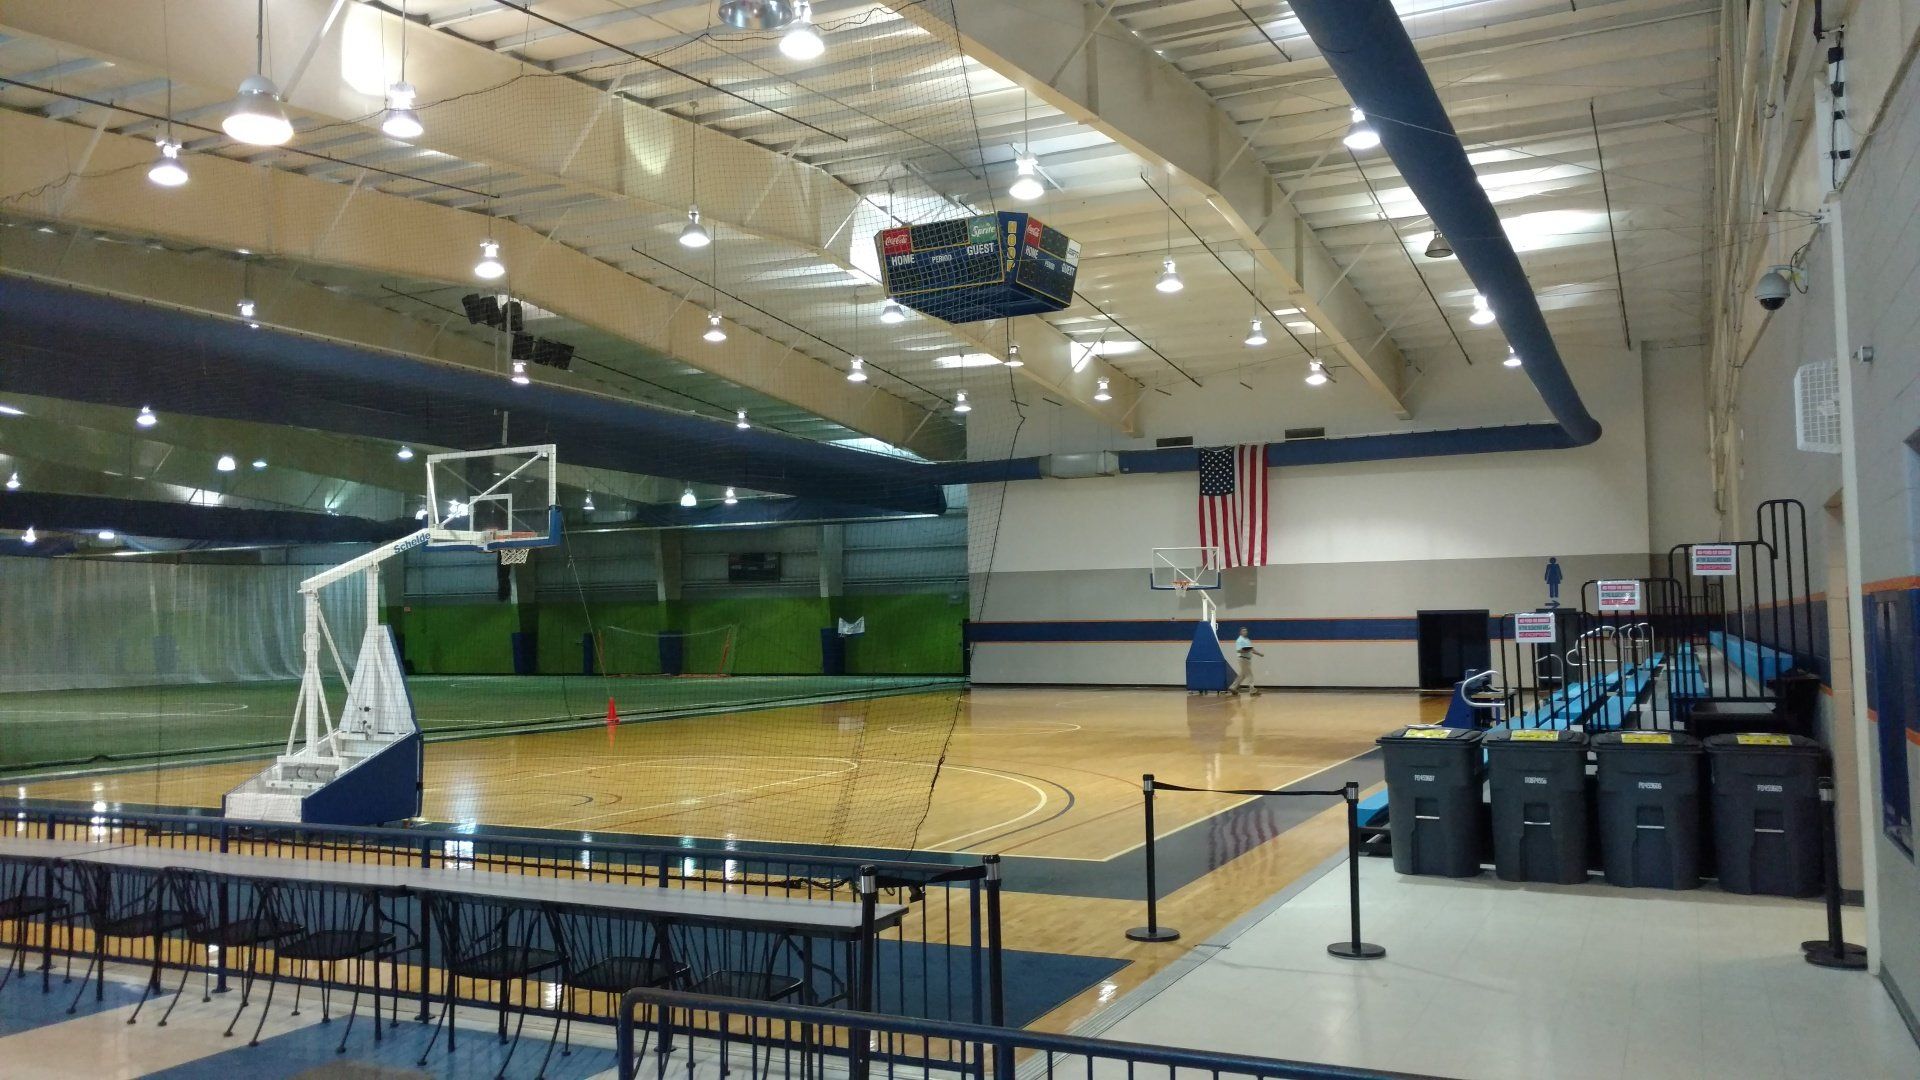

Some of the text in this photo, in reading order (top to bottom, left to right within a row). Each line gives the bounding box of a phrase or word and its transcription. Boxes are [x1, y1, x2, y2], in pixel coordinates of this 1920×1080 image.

[971, 223, 996, 237] Sprite
[891, 242, 995, 267] HOME PERIOD GUEST
[393, 532, 431, 554] Schelde
